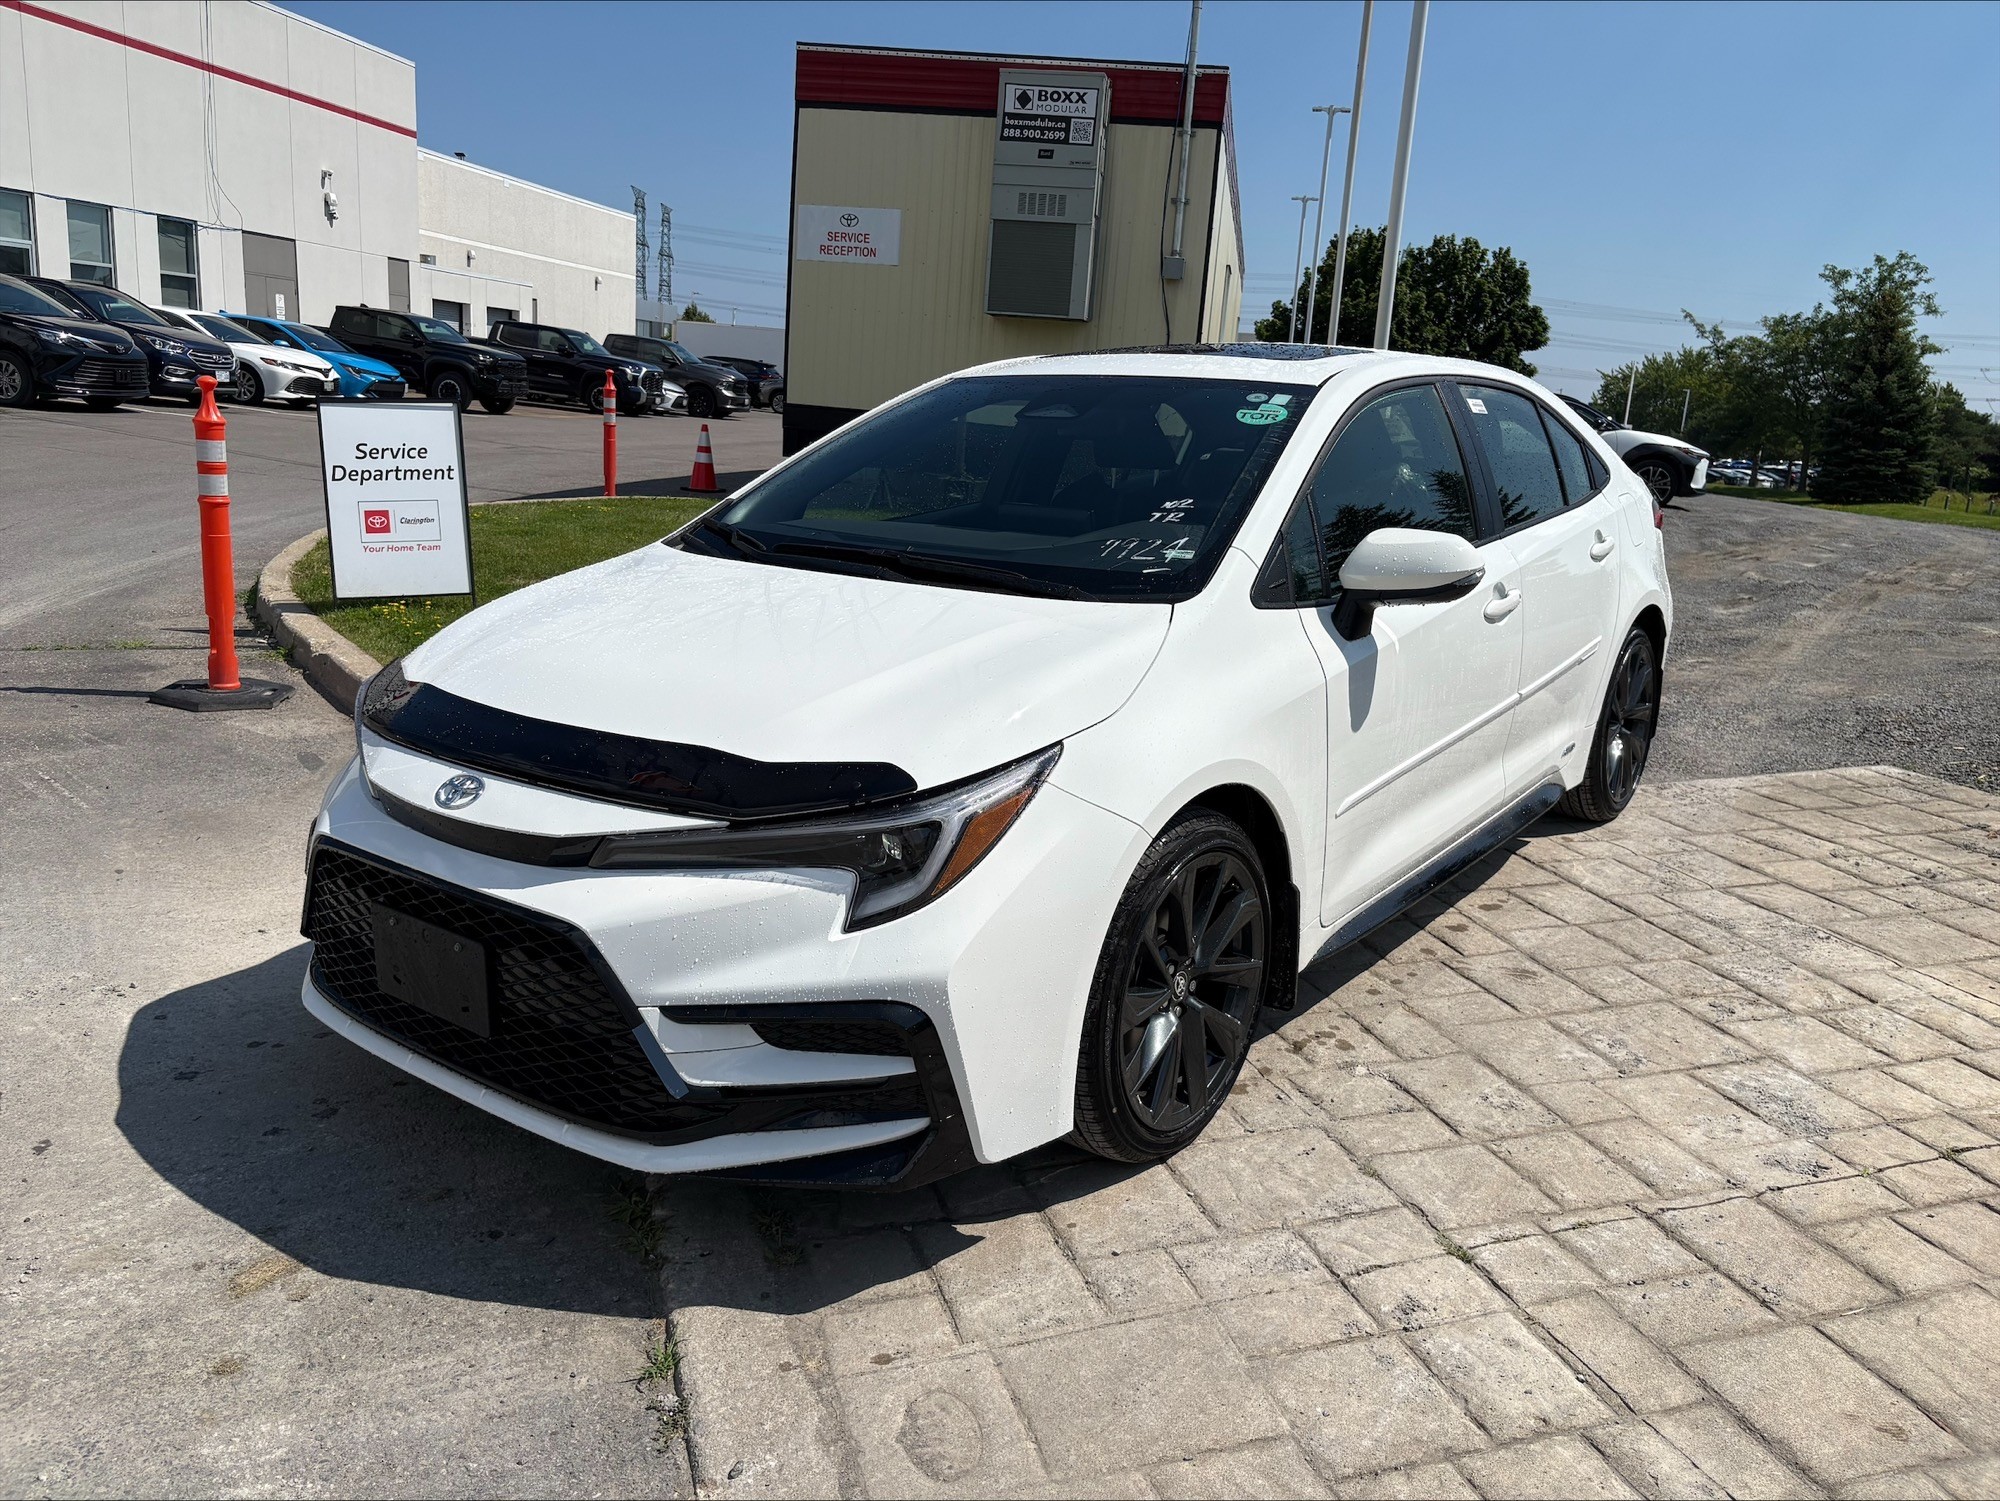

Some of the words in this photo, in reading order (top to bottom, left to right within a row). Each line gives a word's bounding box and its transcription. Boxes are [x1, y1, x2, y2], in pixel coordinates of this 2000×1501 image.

[1037, 89, 1089, 104] BOXX
[1036, 104, 1087, 114] MODULAR
[1004, 116, 1066, 128] boxxmodular.ca
[1003, 128, 1066, 140] 888.900.2699
[827, 231, 871, 244] SERVICE
[819, 245, 877, 258] RECEPTION
[1239, 411, 1279, 421] TOR
[355, 442, 428, 460] Service
[331, 464, 455, 486] Department
[399, 516, 435, 525] Clarington
[362, 544, 385, 553] Your
[387, 544, 414, 552] Home
[416, 543, 441, 552] Team
